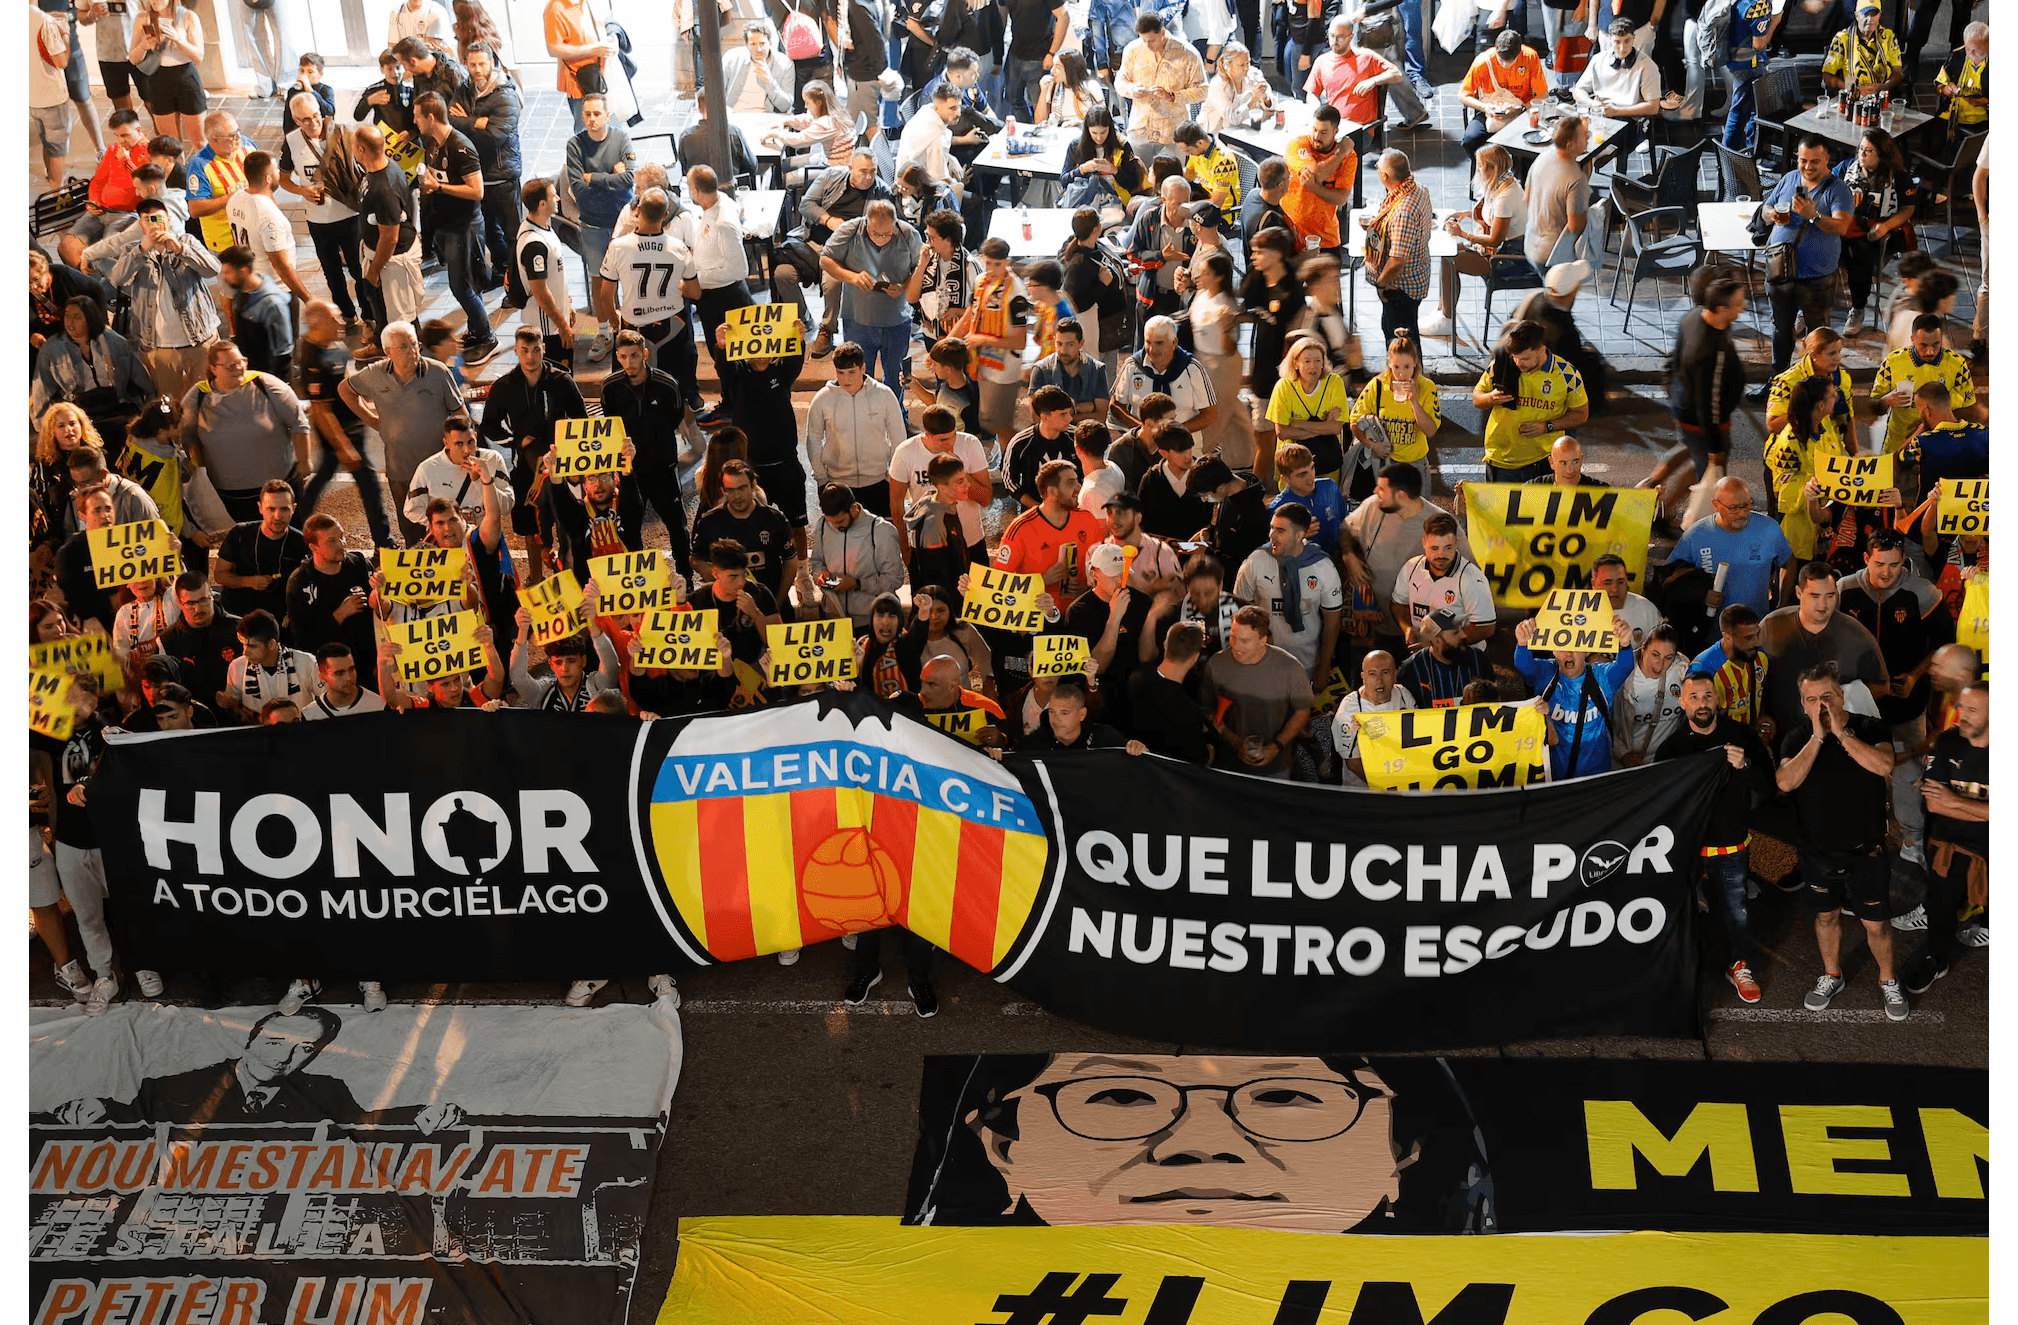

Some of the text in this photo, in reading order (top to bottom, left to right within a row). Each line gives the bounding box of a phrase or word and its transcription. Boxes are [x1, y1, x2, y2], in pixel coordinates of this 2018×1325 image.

[638, 242, 663, 252] HUGO
[630, 262, 674, 300] 77
[740, 305, 782, 325] LIM
[729, 337, 797, 358] HOME
[565, 419, 613, 440] LIM
[555, 452, 627, 474] HOME
[1827, 456, 1878, 475] LIM
[1505, 490, 1619, 529] LIM
[107, 521, 155, 548] LIM
[1530, 532, 1587, 558] GO
[99, 554, 176, 585] HOME
[397, 549, 448, 567] LIM
[607, 552, 656, 576] LIM
[1699, 547, 1714, 574] BMW
[383, 580, 463, 596] HOME
[981, 569, 1032, 594] LIM
[1484, 563, 1637, 597] HOM
[600, 587, 672, 612] HOME
[1547, 591, 1602, 611] LIM
[651, 612, 704, 632] LIM
[964, 602, 1042, 628] HOME
[408, 615, 458, 644] LIM
[784, 621, 836, 646] LIM
[1531, 628, 1615, 649] HOME
[637, 647, 718, 665] HOME
[1046, 637, 1079, 651] LIM
[404, 646, 482, 680] HOME
[1037, 661, 1087, 675] HOME
[1054, 652, 1074, 662] GO
[773, 658, 853, 683] HOME
[1401, 705, 1518, 749] LIM
[1433, 740, 1494, 771] GO
[674, 747, 1026, 827] VALENCIA C.F.
[138, 787, 601, 880] HONOR
[1075, 829, 1230, 896] QUE
[1251, 838, 1513, 902] LUCHA
[153, 877, 609, 920] A TODO MURCIÉLAGO
[1068, 896, 1667, 978] NUESTRO ESCUDO
[31, 1141, 157, 1190] NOU
[477, 1148, 581, 1193] ATE
[40, 1278, 425, 1325] PETER LIM
